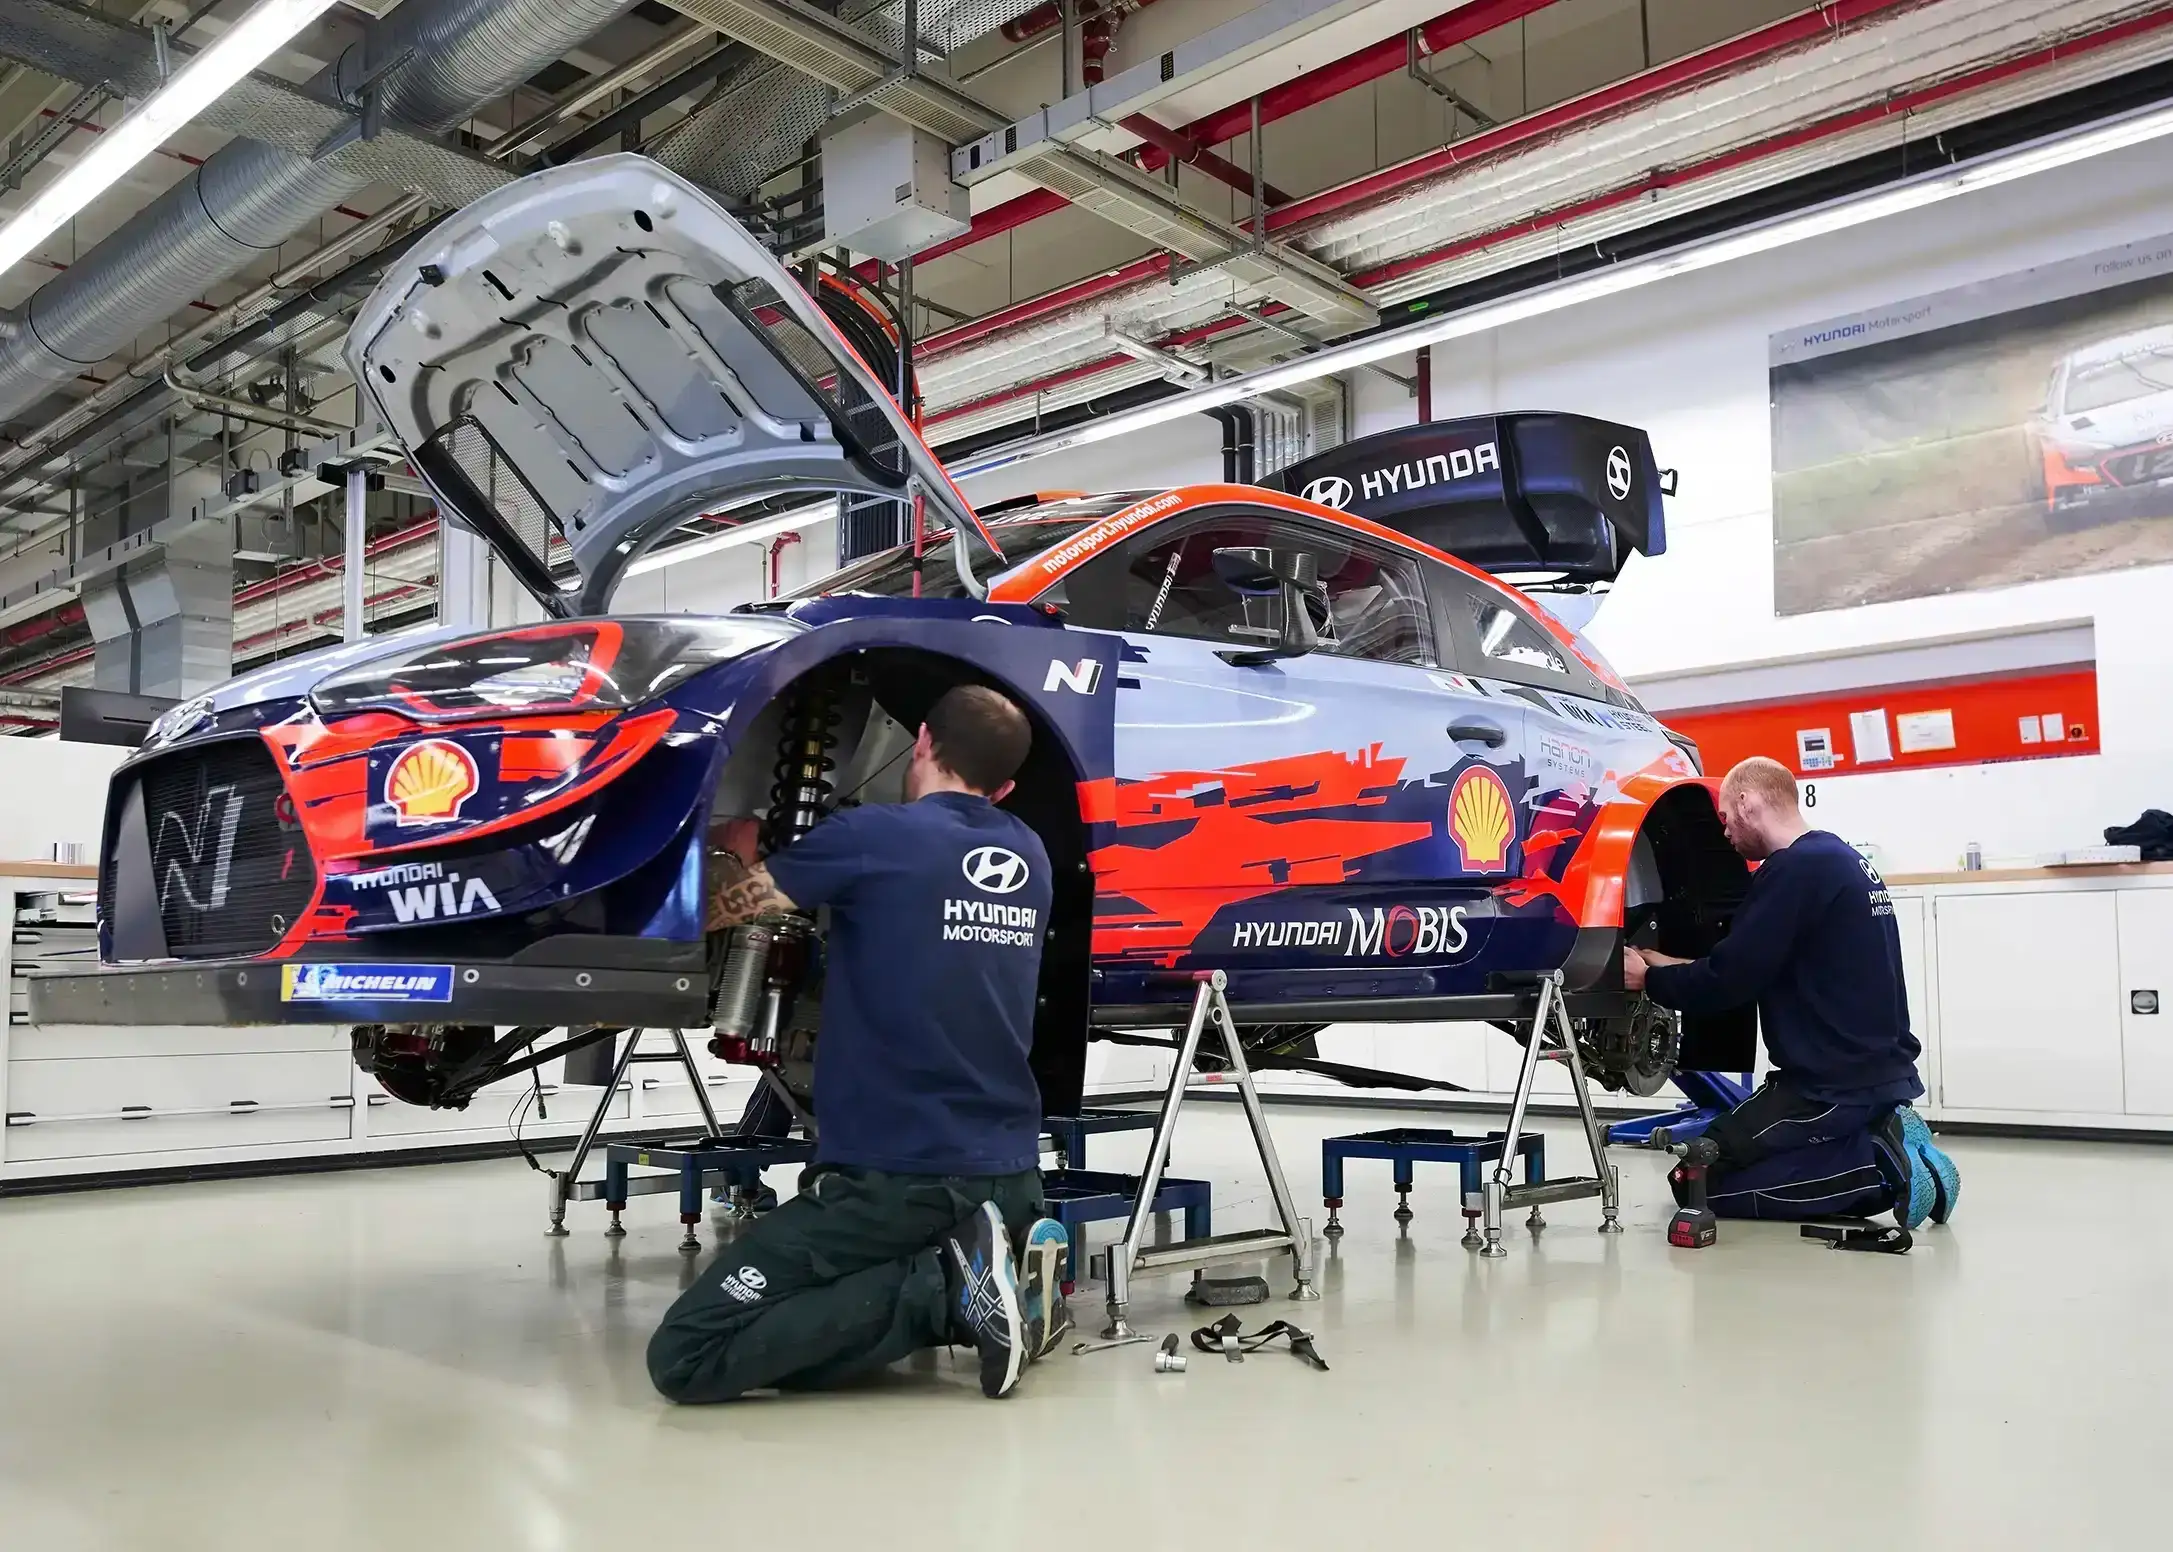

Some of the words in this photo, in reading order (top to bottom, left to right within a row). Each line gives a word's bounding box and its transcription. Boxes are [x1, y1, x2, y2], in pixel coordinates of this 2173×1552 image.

[2138, 254, 2152, 266] us
[2156, 249, 2172, 261] on
[1804, 323, 1865, 347] HYUNDAI
[1868, 306, 1932, 332] Motorsport
[1361, 442, 1500, 500] HYUNDA
[1042, 494, 1184, 574] motorsport.hyundai.com
[1547, 759, 1586, 778] SYSTEMS
[1805, 784, 1816, 808] 8
[351, 862, 443, 891] HYUNDAI
[944, 899, 1037, 929] HYUNDAI
[943, 925, 1034, 947] MOTORSPORT
[1232, 921, 1342, 948] HYUNDAI
[1344, 905, 1467, 957] MOBIS
[324, 975, 436, 991] MICHELIN
